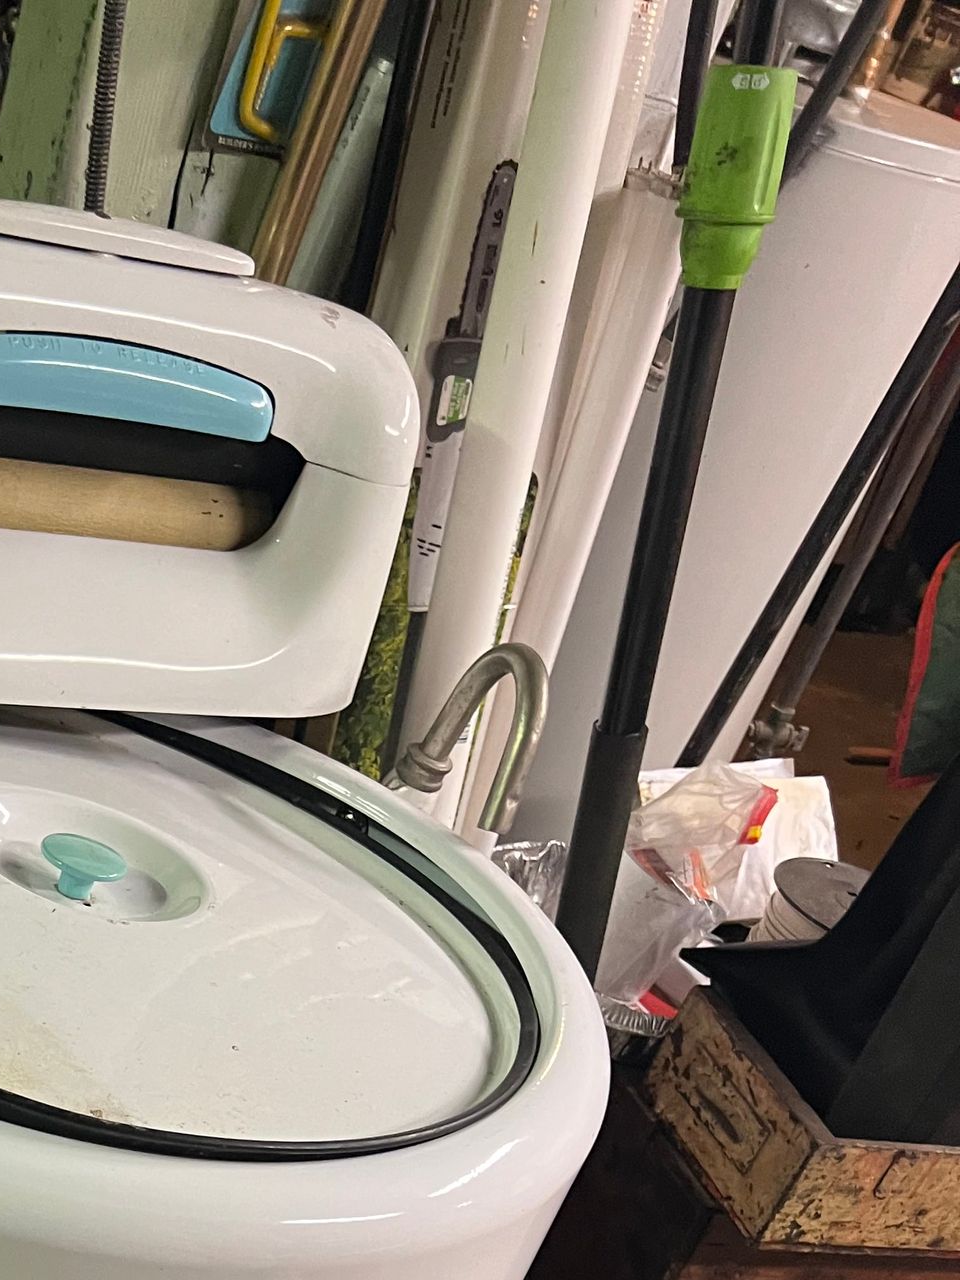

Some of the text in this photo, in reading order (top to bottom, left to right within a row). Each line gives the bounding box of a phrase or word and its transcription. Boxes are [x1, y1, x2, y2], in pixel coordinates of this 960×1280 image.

[8, 336, 206, 375] PUSH TO RELEASE
